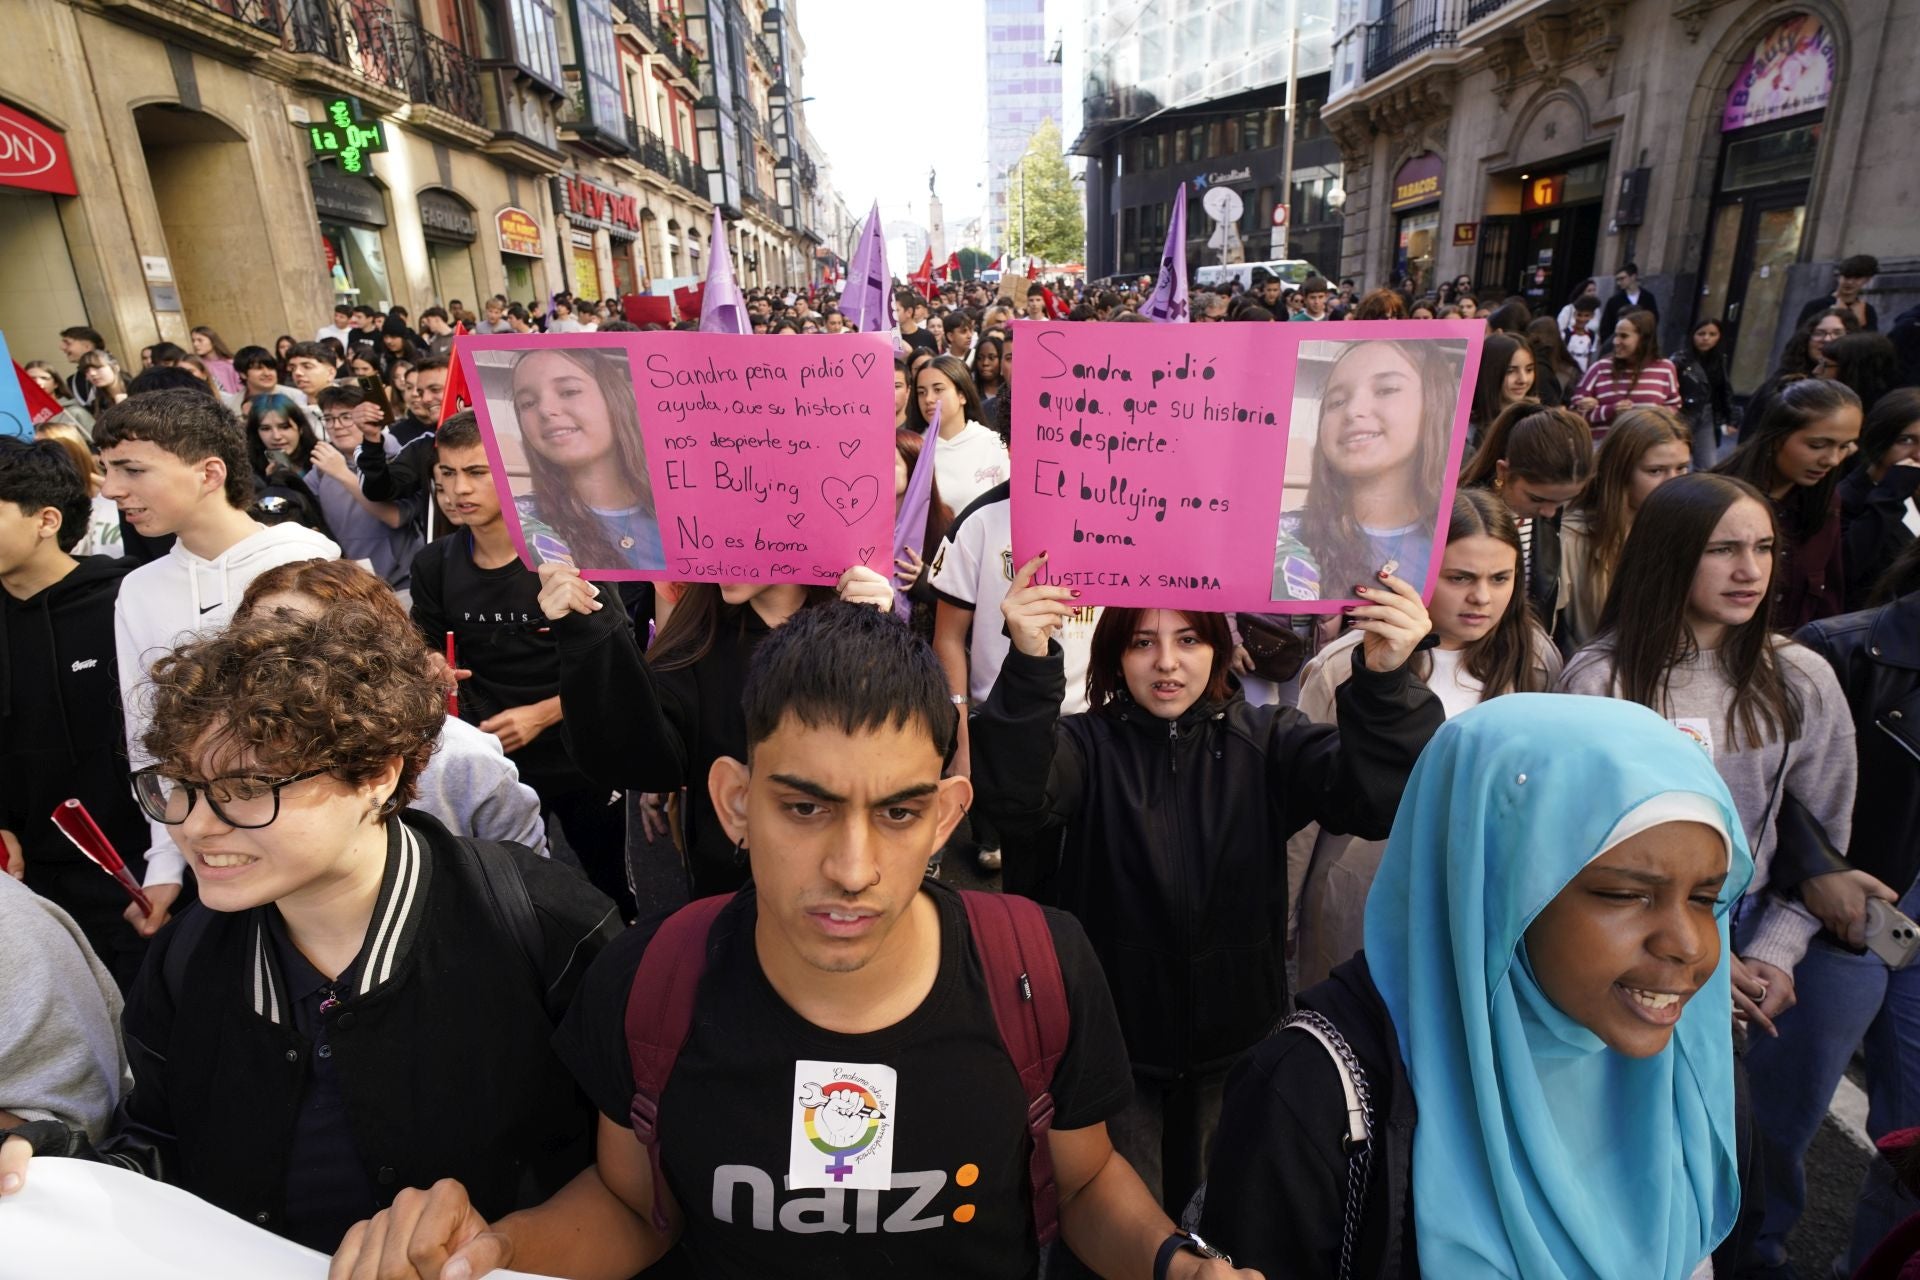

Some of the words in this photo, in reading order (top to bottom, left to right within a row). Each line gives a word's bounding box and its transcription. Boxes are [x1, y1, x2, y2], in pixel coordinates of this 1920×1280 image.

[1397, 176, 1438, 199] TABACOS
[567, 177, 606, 220] NEW
[607, 192, 640, 233] YORK
[421, 206, 477, 236] FARMACIA
[646, 354, 738, 388] Sandra
[745, 362, 788, 391] peña
[800, 356, 844, 388] pidió
[1037, 331, 1132, 382] Sandra
[1152, 353, 1217, 389] pidió
[657, 391, 728, 422] ayuda,
[769, 402, 786, 416] su
[795, 397, 871, 417] historia
[1123, 398, 1157, 425] que
[1203, 396, 1278, 426] historia
[665, 434, 697, 450] nos
[710, 429, 782, 451] despierte
[1037, 423, 1064, 442] nos
[665, 460, 697, 489] EL
[714, 460, 799, 504] Bullying
[1035, 459, 1066, 498] El
[1080, 472, 1167, 522] bullying
[1180, 497, 1202, 509] no
[1209, 499, 1230, 512] es
[677, 515, 714, 550] No
[725, 537, 745, 549] es
[754, 528, 809, 552] broma
[1073, 519, 1136, 546] broma
[677, 557, 761, 578] Justicia
[932, 547, 946, 578] 4
[1158, 574, 1221, 590] SANDRA
